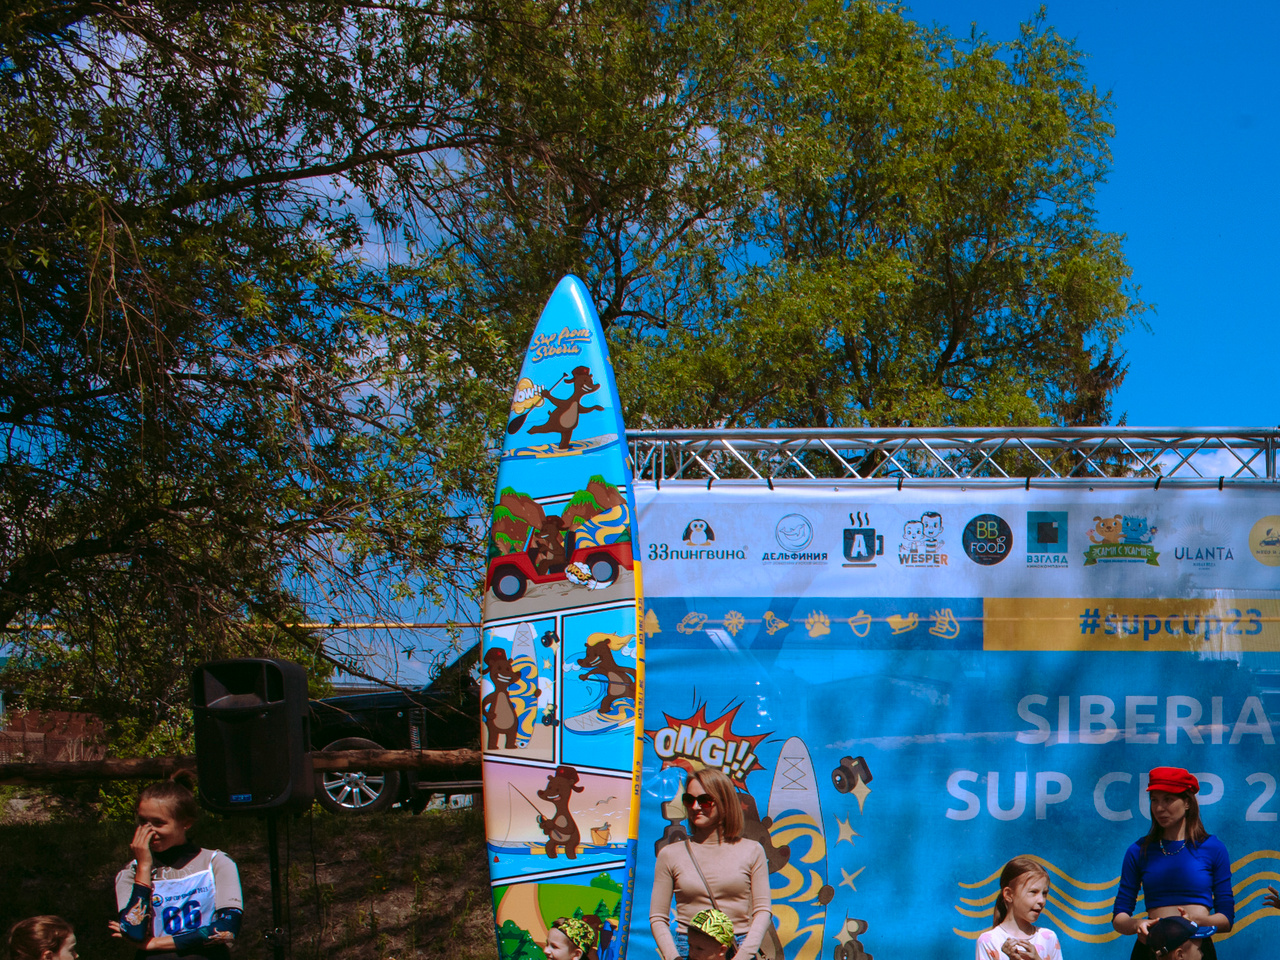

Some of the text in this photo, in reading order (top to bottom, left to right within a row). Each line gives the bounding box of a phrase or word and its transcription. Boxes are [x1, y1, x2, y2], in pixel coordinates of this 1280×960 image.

[976, 520, 999, 539] BB
[970, 541, 1006, 553] FOOD
[1174, 547, 1234, 561] ULANTA
[762, 552, 828, 561] ДЕЛЬФИНИЯ
[899, 553, 949, 566] WESPER
[1026, 554, 1068, 564] ВЗГЛЯД
[1078, 608, 1262, 641] #supcup23
[654, 723, 757, 781] OMG!!!
[945, 770, 1072, 821] SUP
[162, 900, 202, 935] 66
